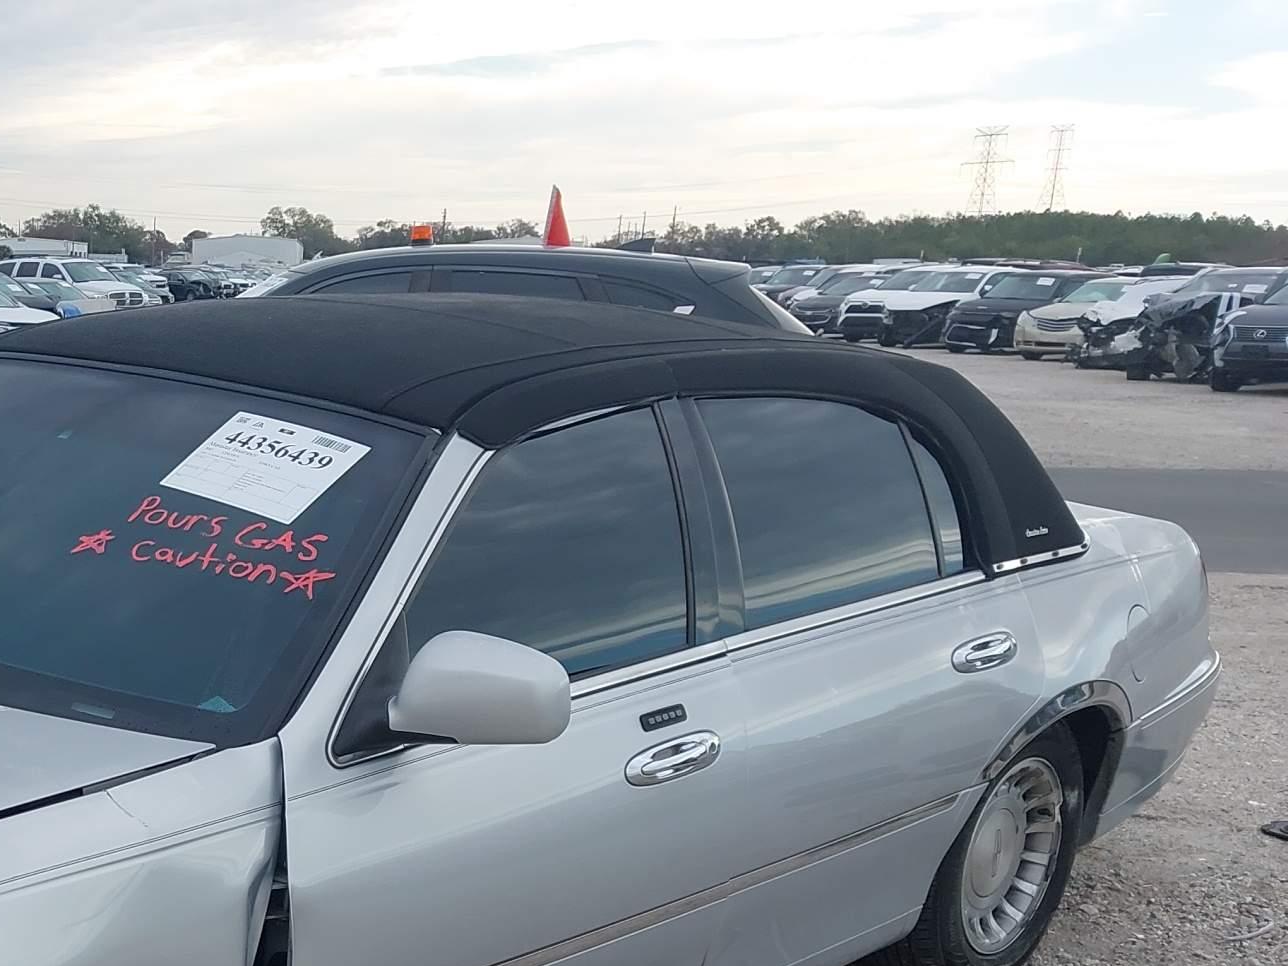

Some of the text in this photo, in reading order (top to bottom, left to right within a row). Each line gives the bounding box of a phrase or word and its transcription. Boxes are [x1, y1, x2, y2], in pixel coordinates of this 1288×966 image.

[224, 430, 335, 470] 44356439
[127, 495, 329, 562] Pours GAS
